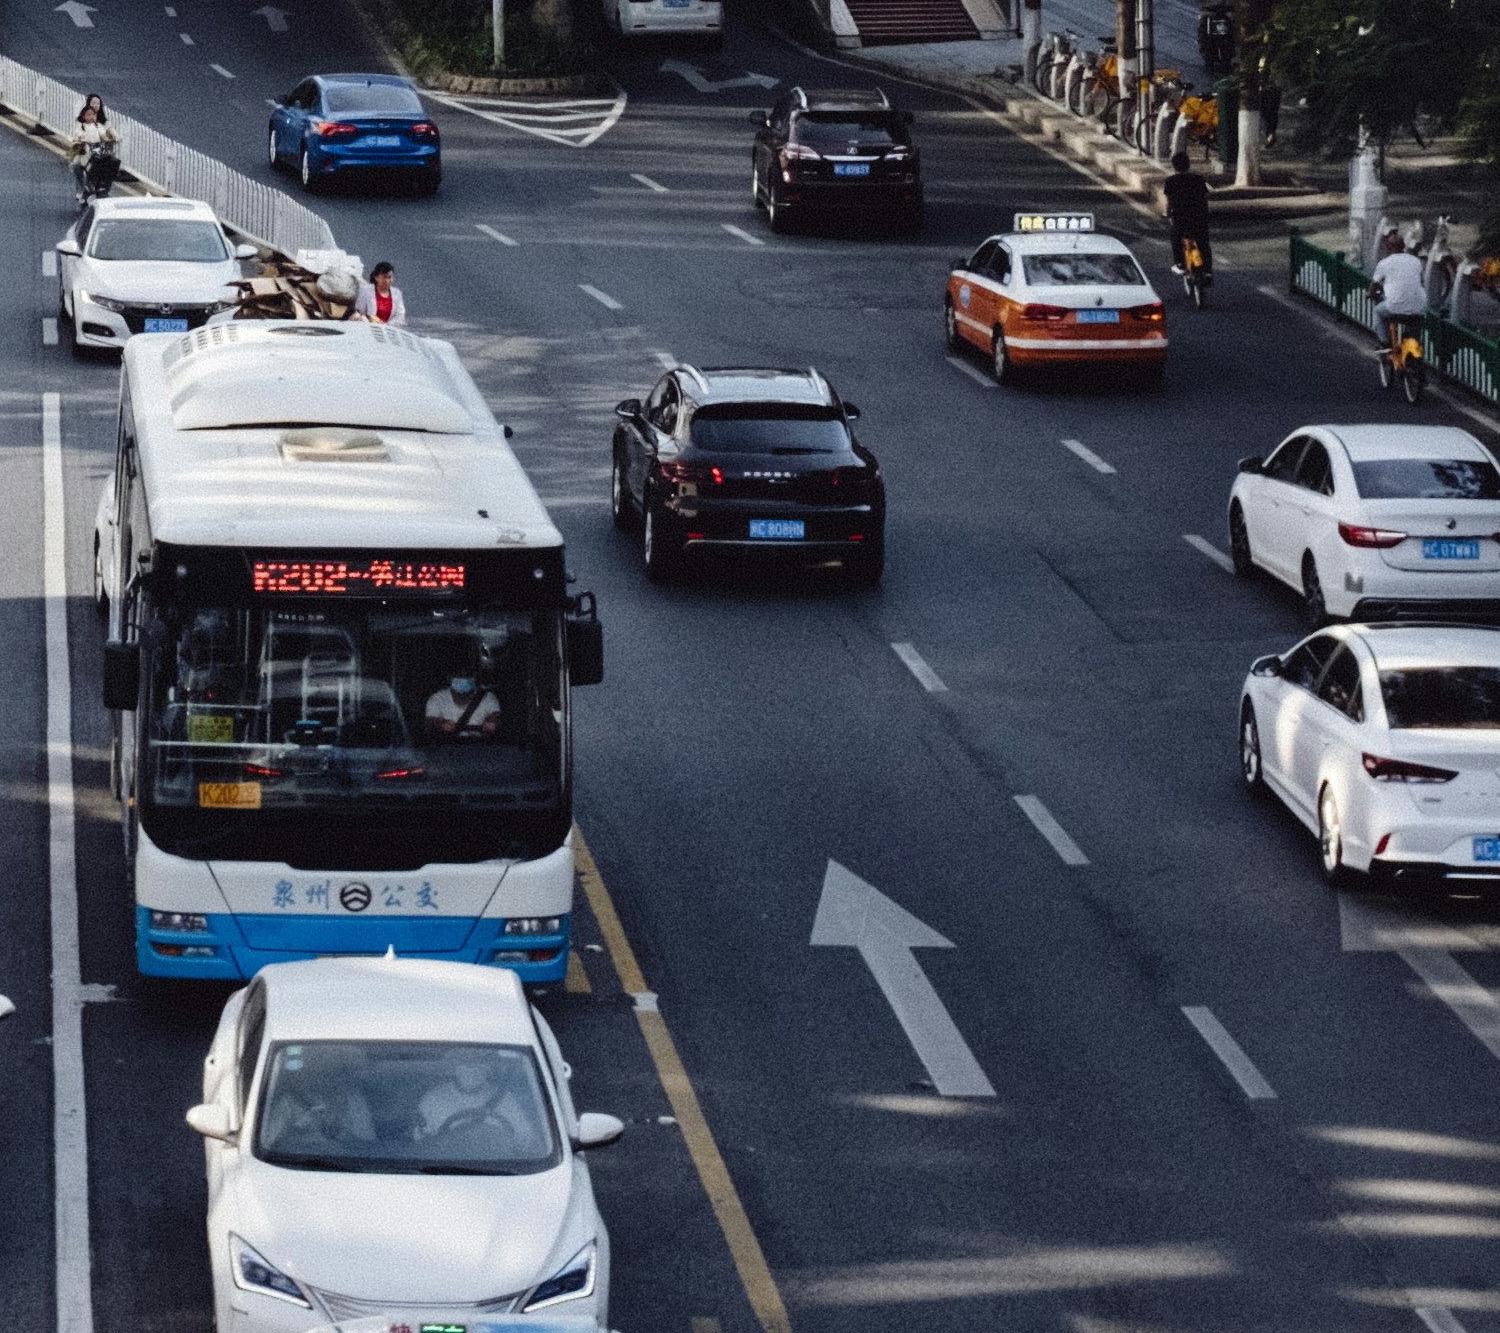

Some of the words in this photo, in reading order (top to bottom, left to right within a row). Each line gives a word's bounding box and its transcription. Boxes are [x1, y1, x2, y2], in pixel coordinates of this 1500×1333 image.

[203, 783, 241, 801] K202
[272, 879, 330, 911] 泉州
[380, 884, 440, 911] 公交
